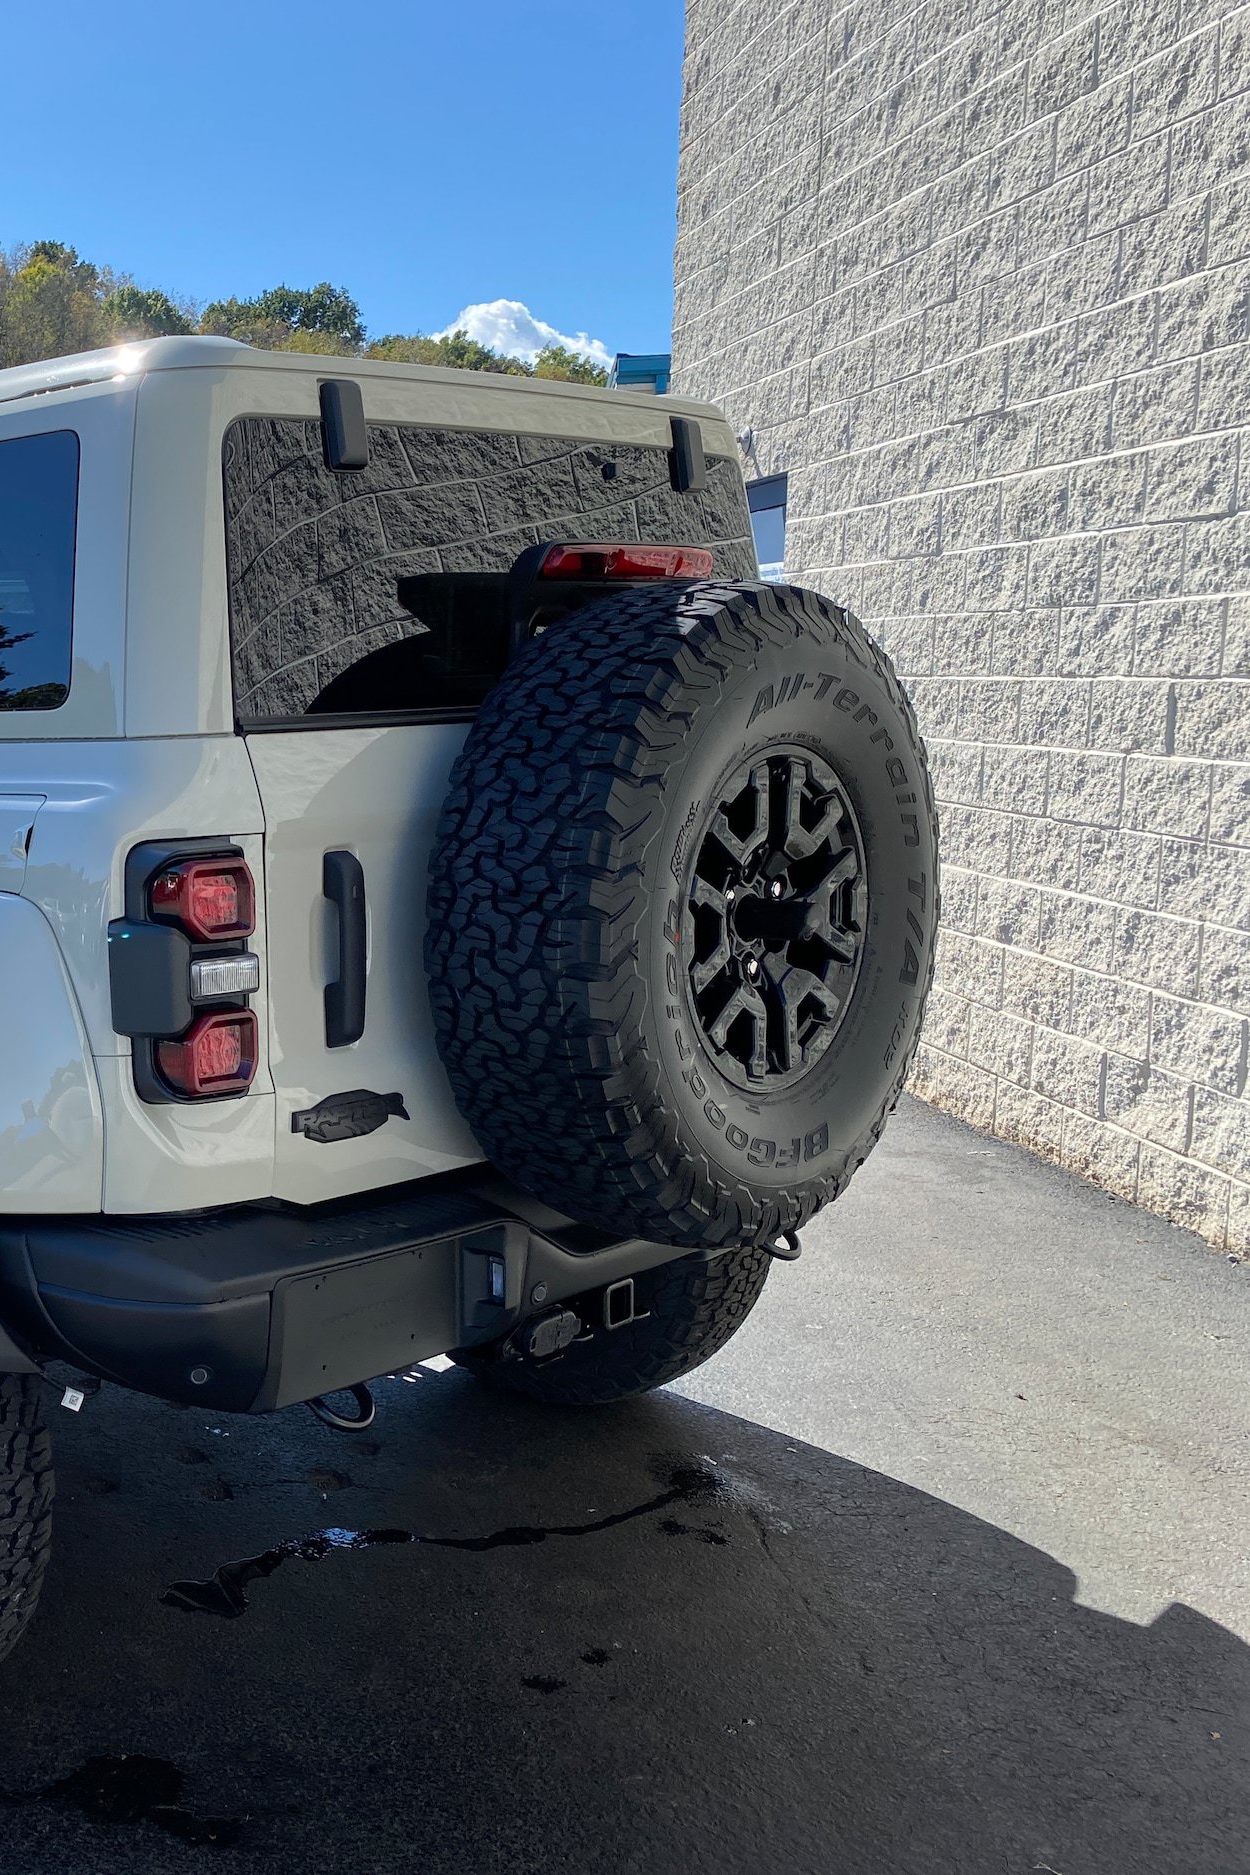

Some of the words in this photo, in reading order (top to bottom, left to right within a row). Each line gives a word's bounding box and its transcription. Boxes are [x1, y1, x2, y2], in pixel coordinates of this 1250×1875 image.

[745, 672, 920, 848] All-Terrain
[899, 871, 926, 987] T/A
[663, 898, 830, 1169] BFGoodrich
